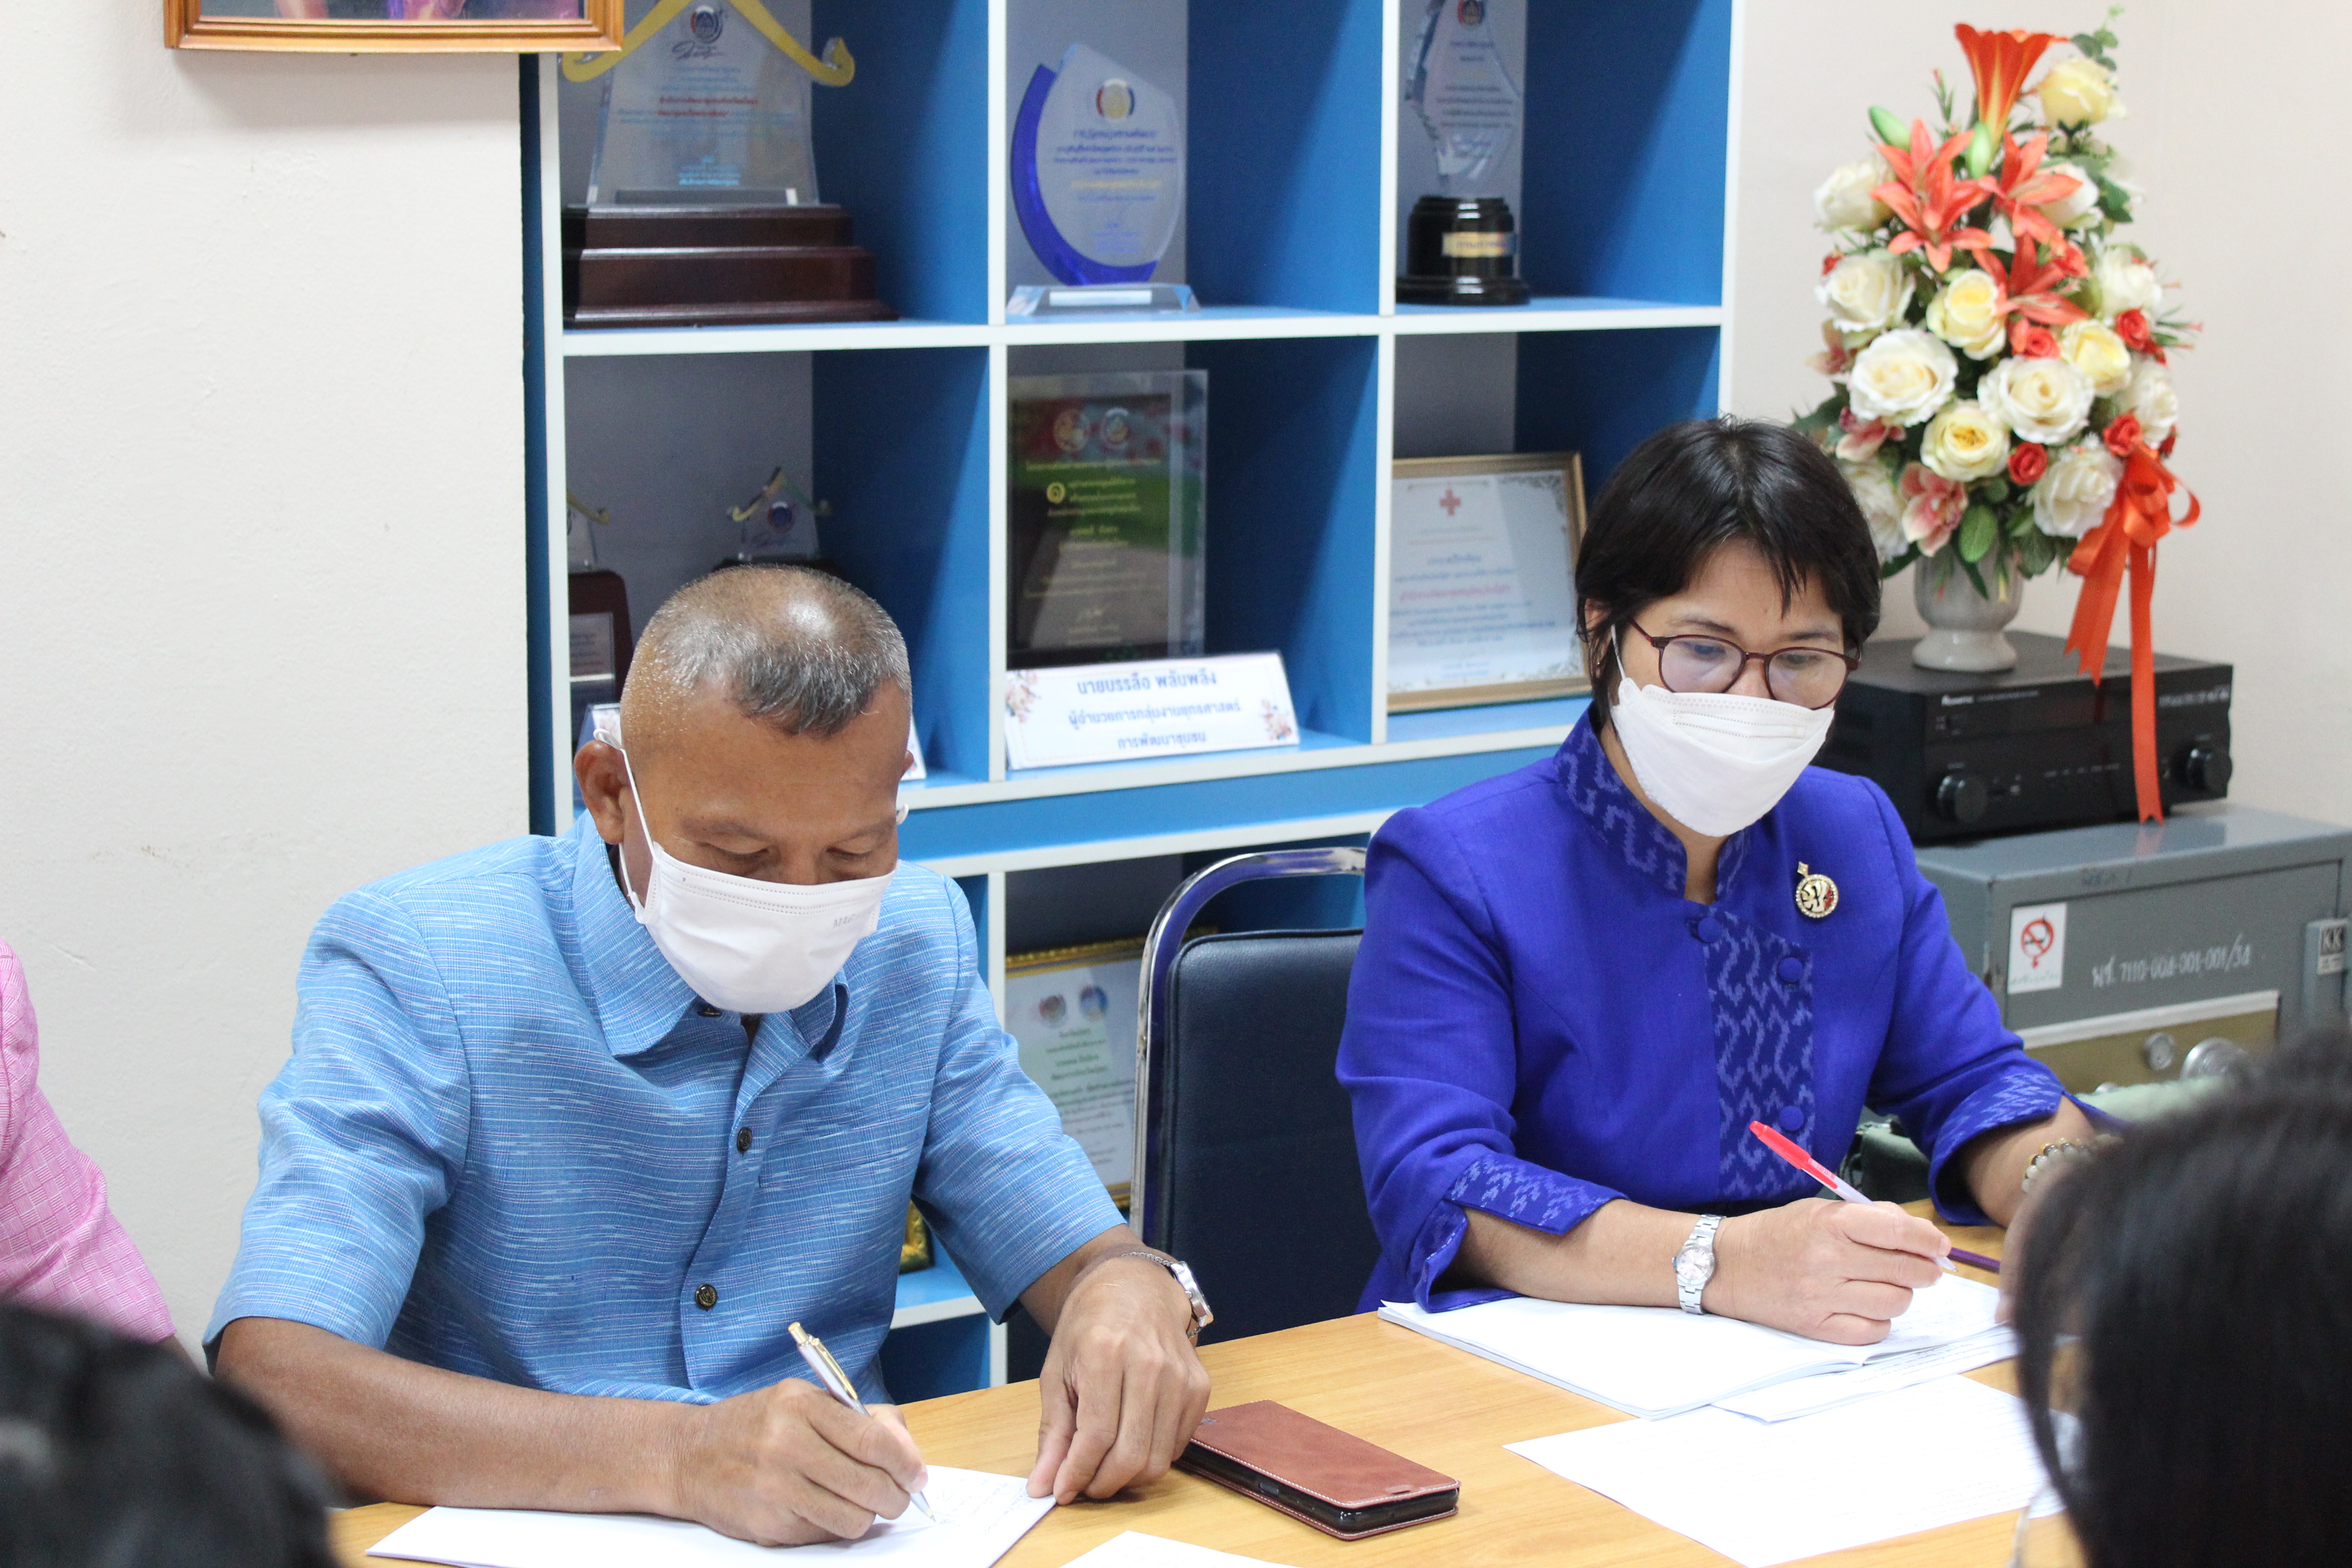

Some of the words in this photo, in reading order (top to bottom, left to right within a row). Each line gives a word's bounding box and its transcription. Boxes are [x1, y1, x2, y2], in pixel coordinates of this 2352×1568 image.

[1077, 672, 1151, 695] นายบรรลือ
[1155, 667, 1217, 689] พลับพลึง
[1068, 698, 1241, 730] ผู้อำนวยการกลุ่มงานยุทธศาสตร์
[1117, 732, 1206, 750] การพัฒนาชุมชน
